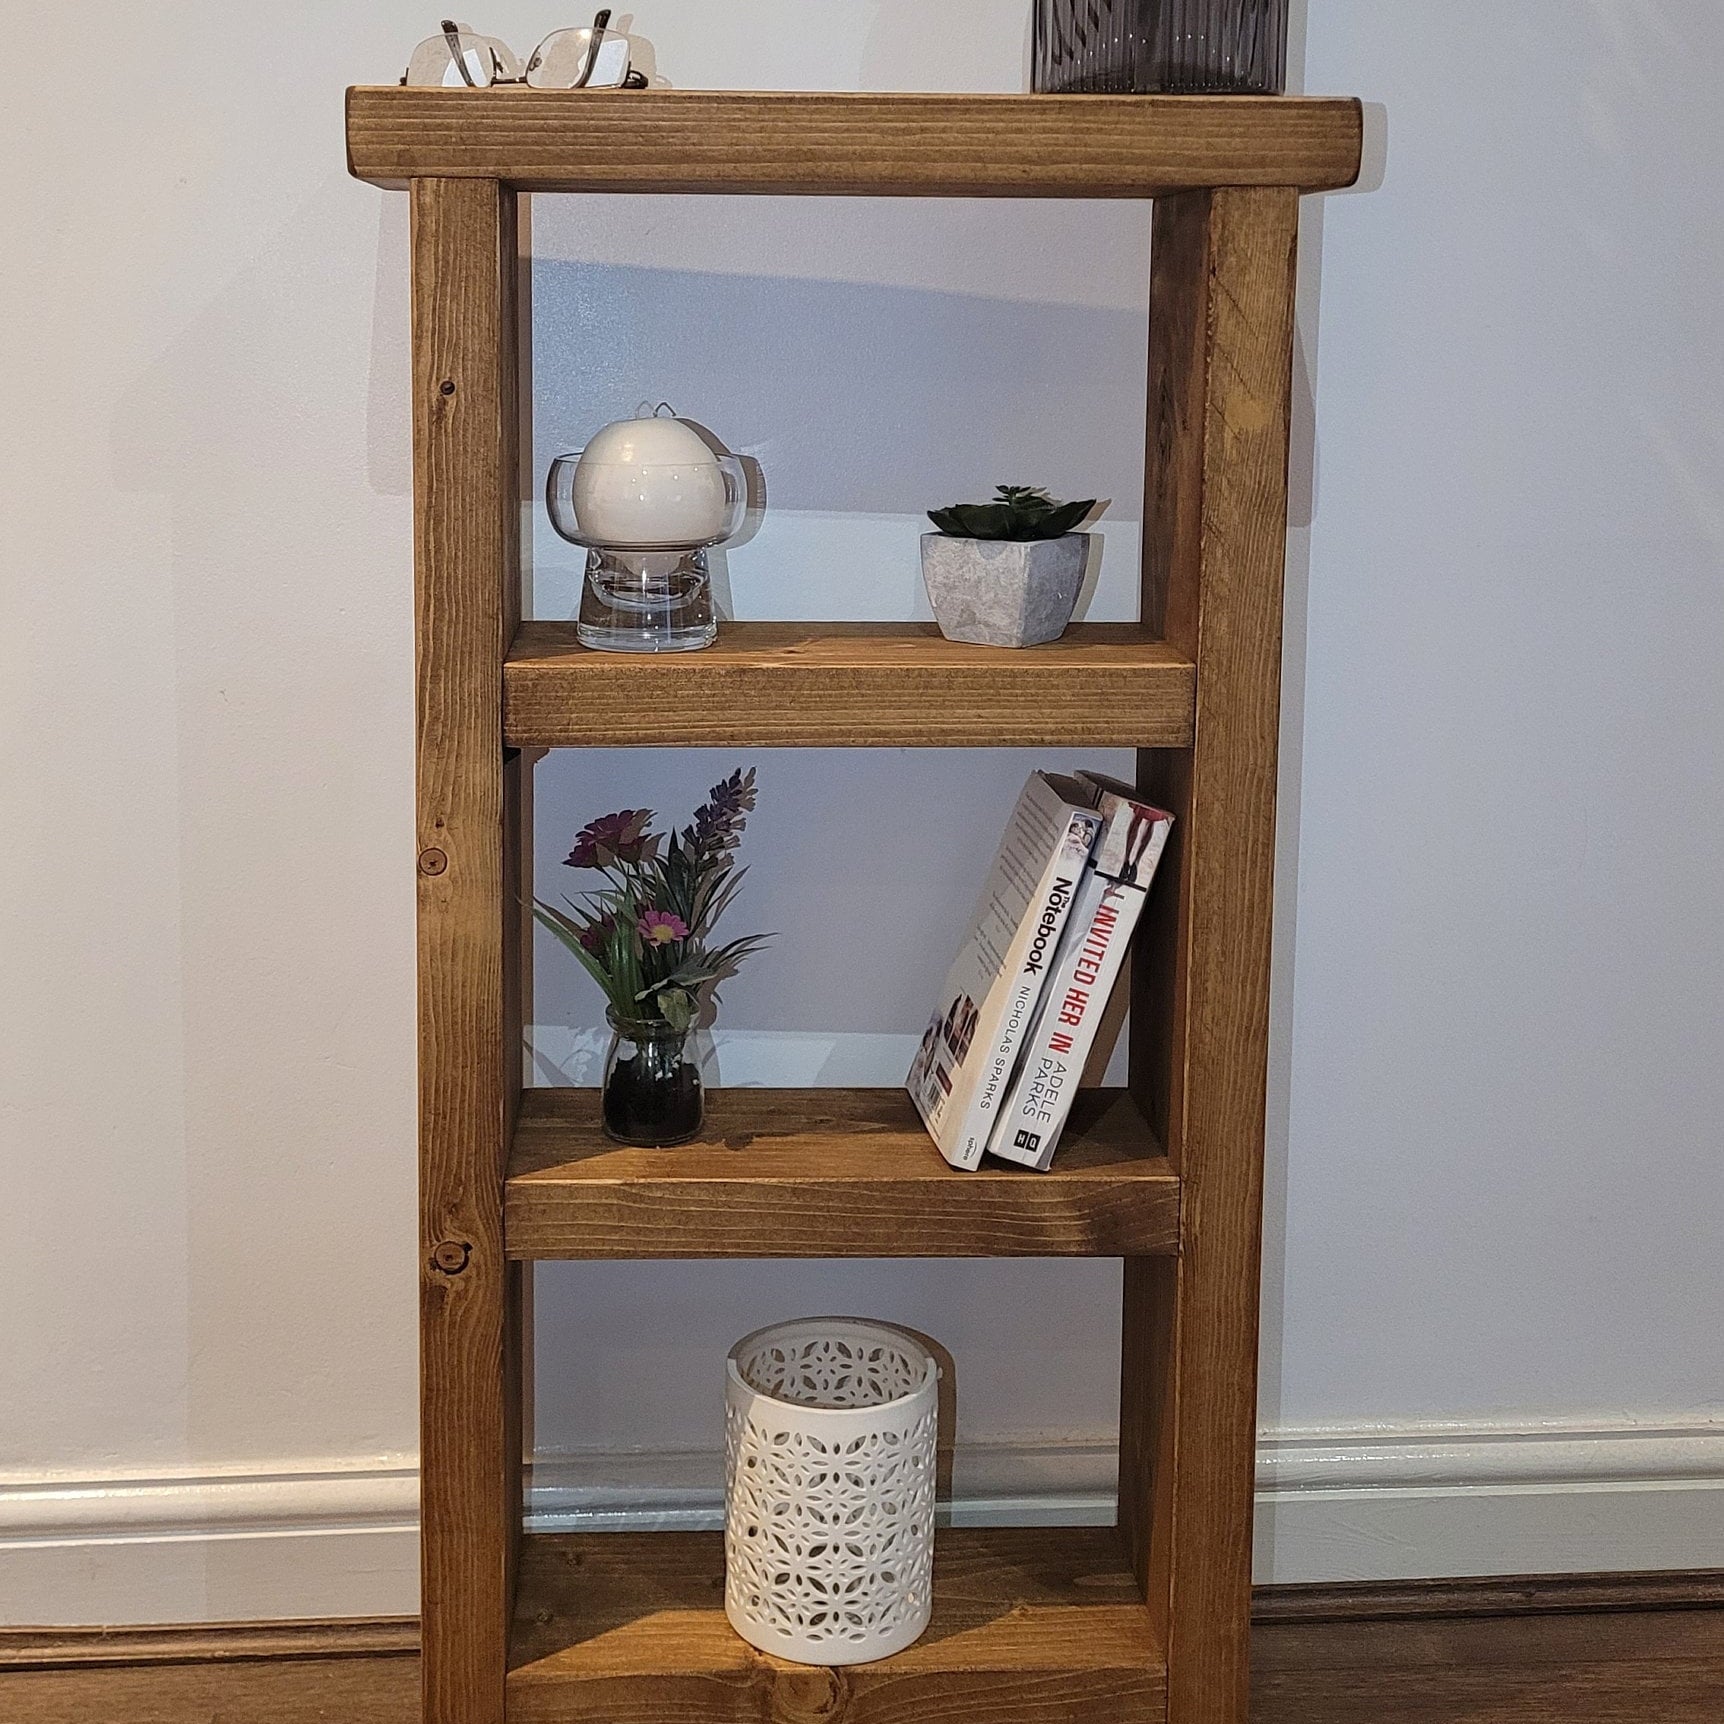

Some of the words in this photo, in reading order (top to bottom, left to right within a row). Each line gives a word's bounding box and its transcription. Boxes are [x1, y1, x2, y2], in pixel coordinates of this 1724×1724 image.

[1023, 877, 1073, 976] Notebook
[1073, 904, 1119, 985] INVITED
[1000, 986, 1031, 1054] NICHOLAS
[1058, 987, 1089, 1027] HER
[1048, 1032, 1074, 1054] IN
[980, 1057, 1006, 1110] SPARKS
[1022, 1057, 1053, 1119] PARKS
[1037, 1061, 1067, 1123] ADELE
